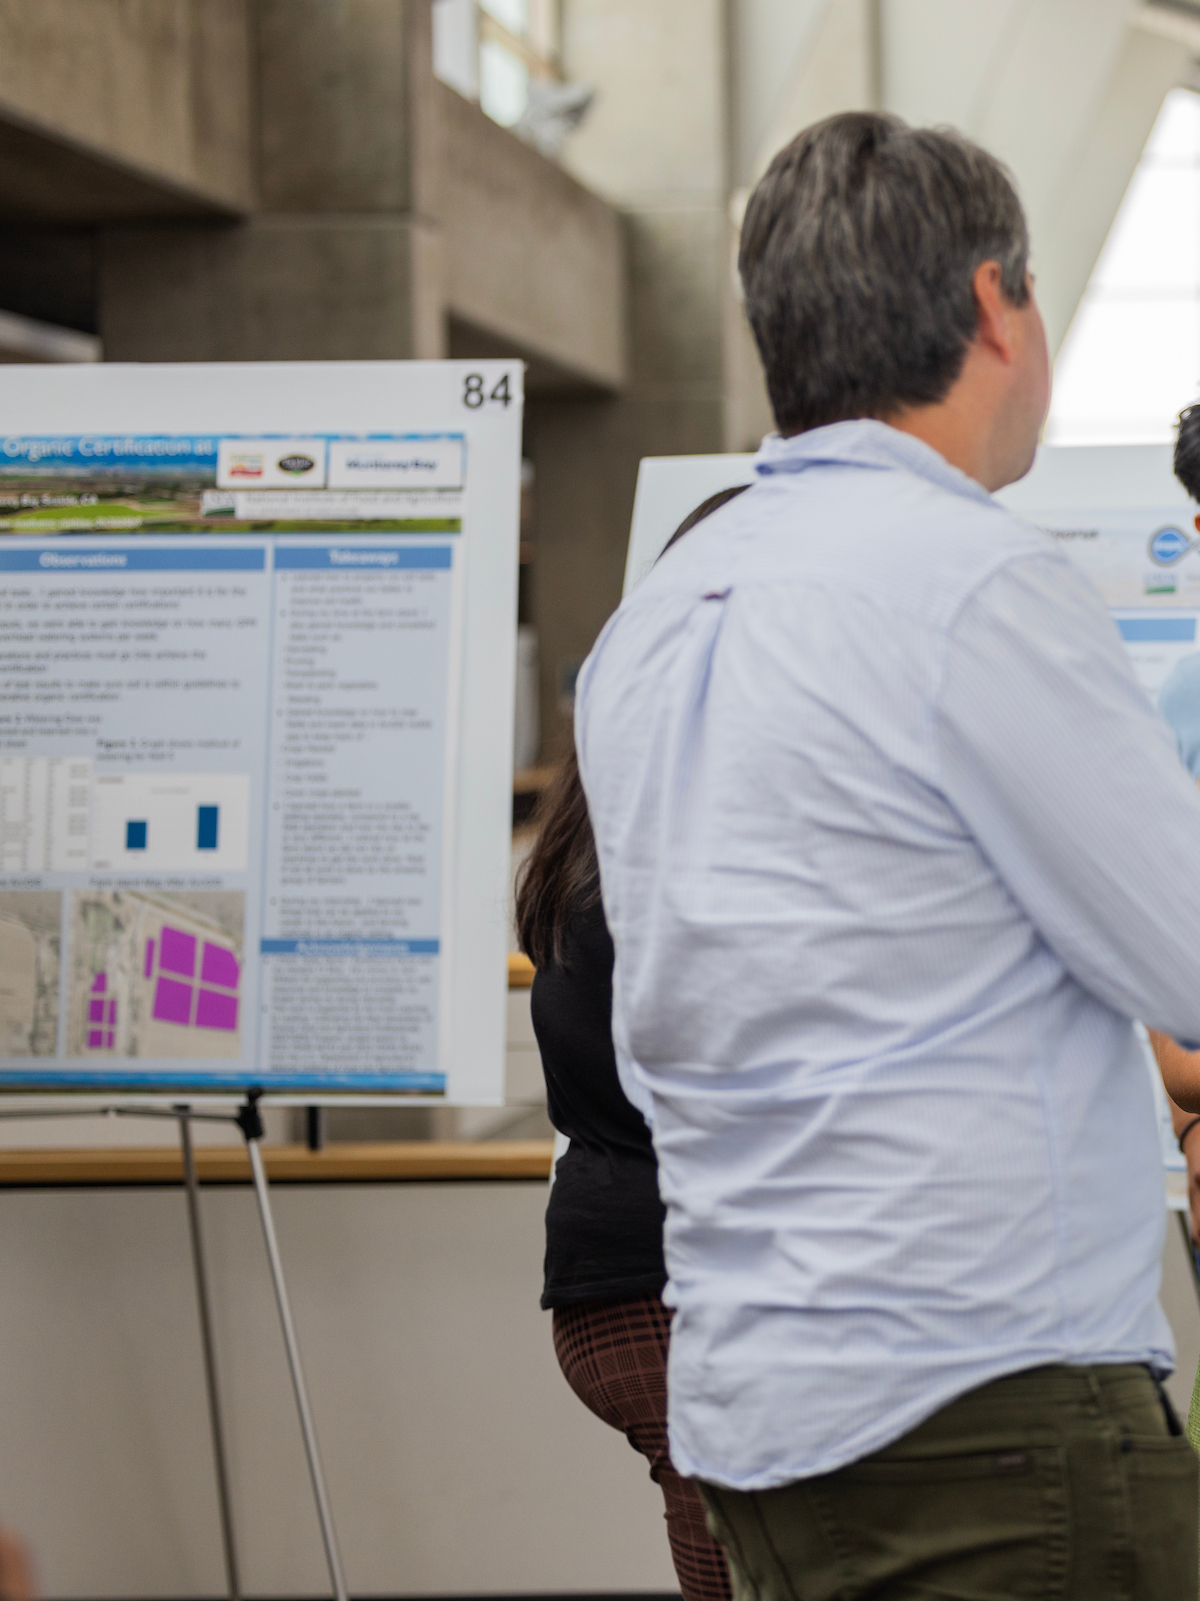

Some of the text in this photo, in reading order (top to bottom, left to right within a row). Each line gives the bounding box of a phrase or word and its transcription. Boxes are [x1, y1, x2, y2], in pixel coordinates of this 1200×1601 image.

[464, 373, 512, 408] 84
[4, 438, 214, 459] Organic Certification at
[40, 553, 127, 566] Observations
[329, 551, 399, 565] Takeaways
